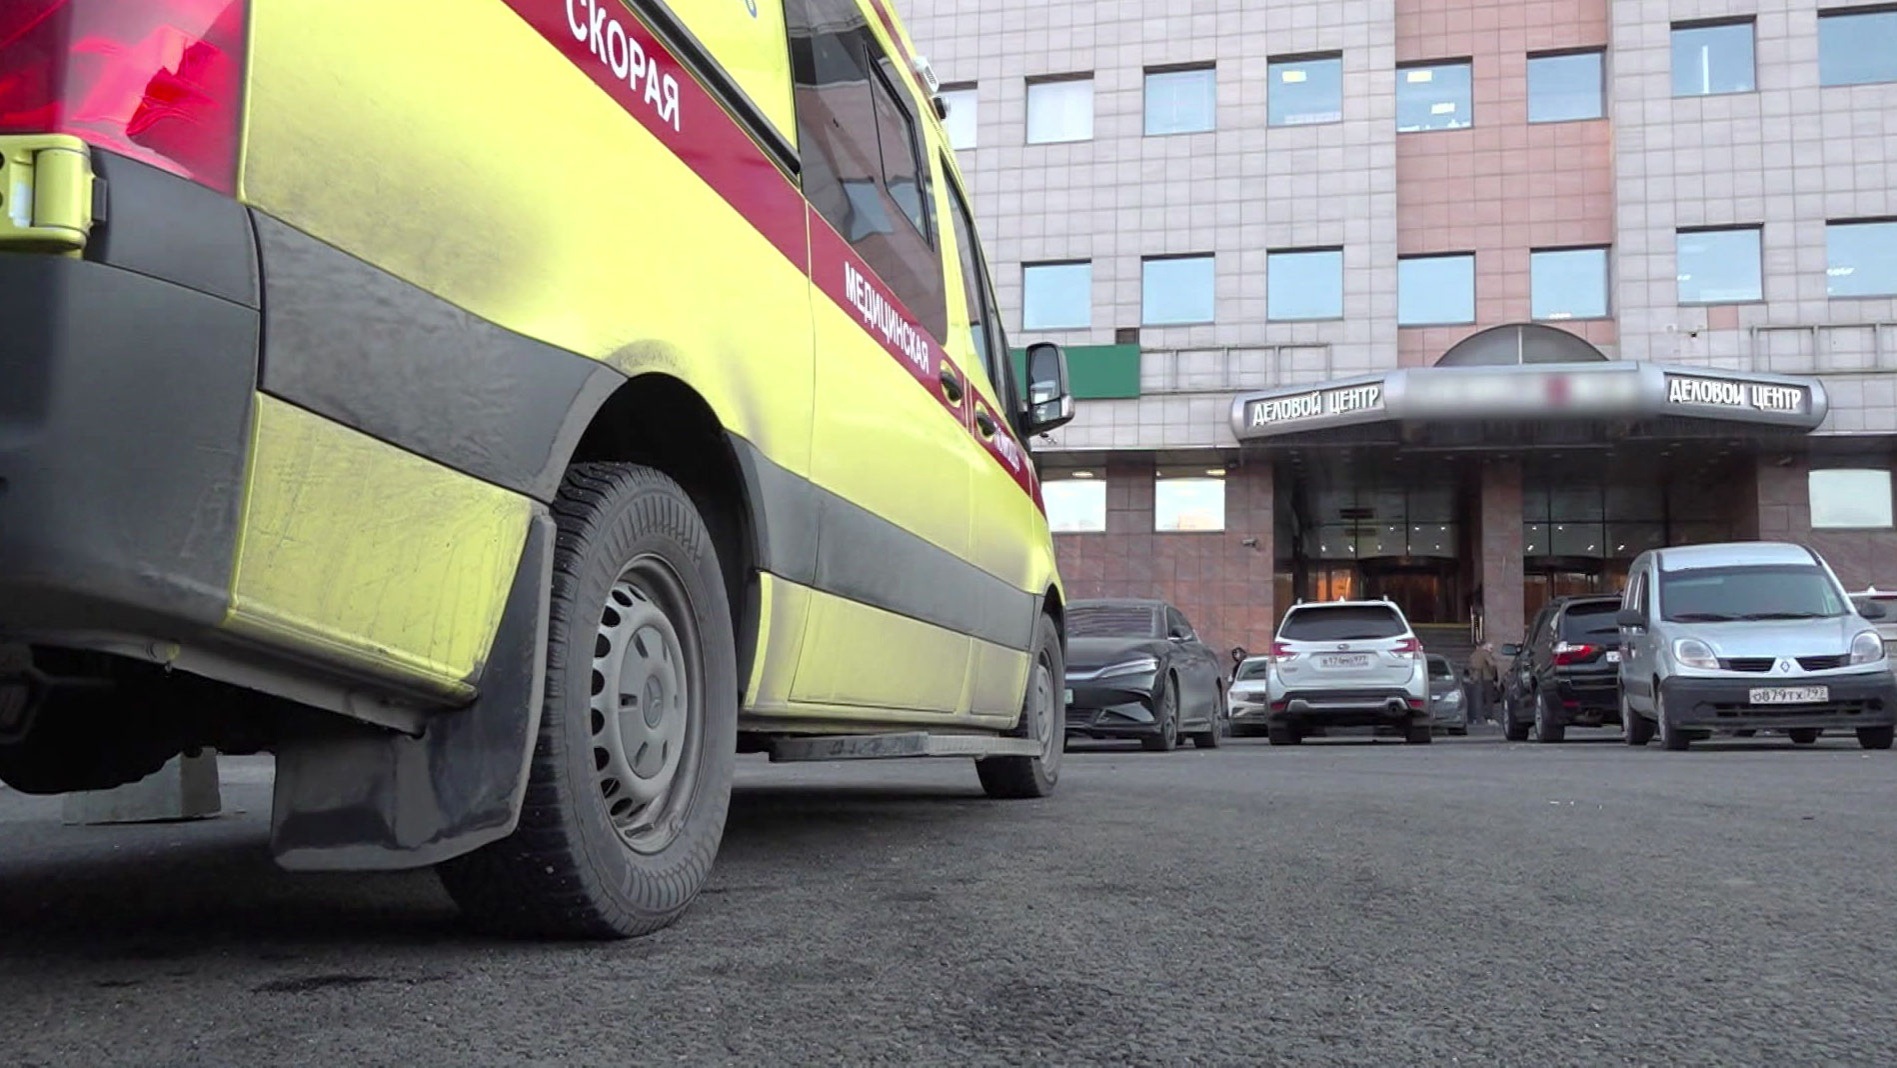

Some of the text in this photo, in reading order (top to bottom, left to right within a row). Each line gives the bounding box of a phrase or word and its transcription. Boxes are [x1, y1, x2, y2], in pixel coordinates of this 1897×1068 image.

[566, 0, 680, 132] СКОРАЯ
[845, 261, 929, 375] МЕДИЦИНСКАЯ
[1253, 390, 1322, 427] ДЕЛОВОЙ
[1330, 387, 1379, 415] ЦЕНТР
[1751, 385, 1801, 410] ЦЕНТР
